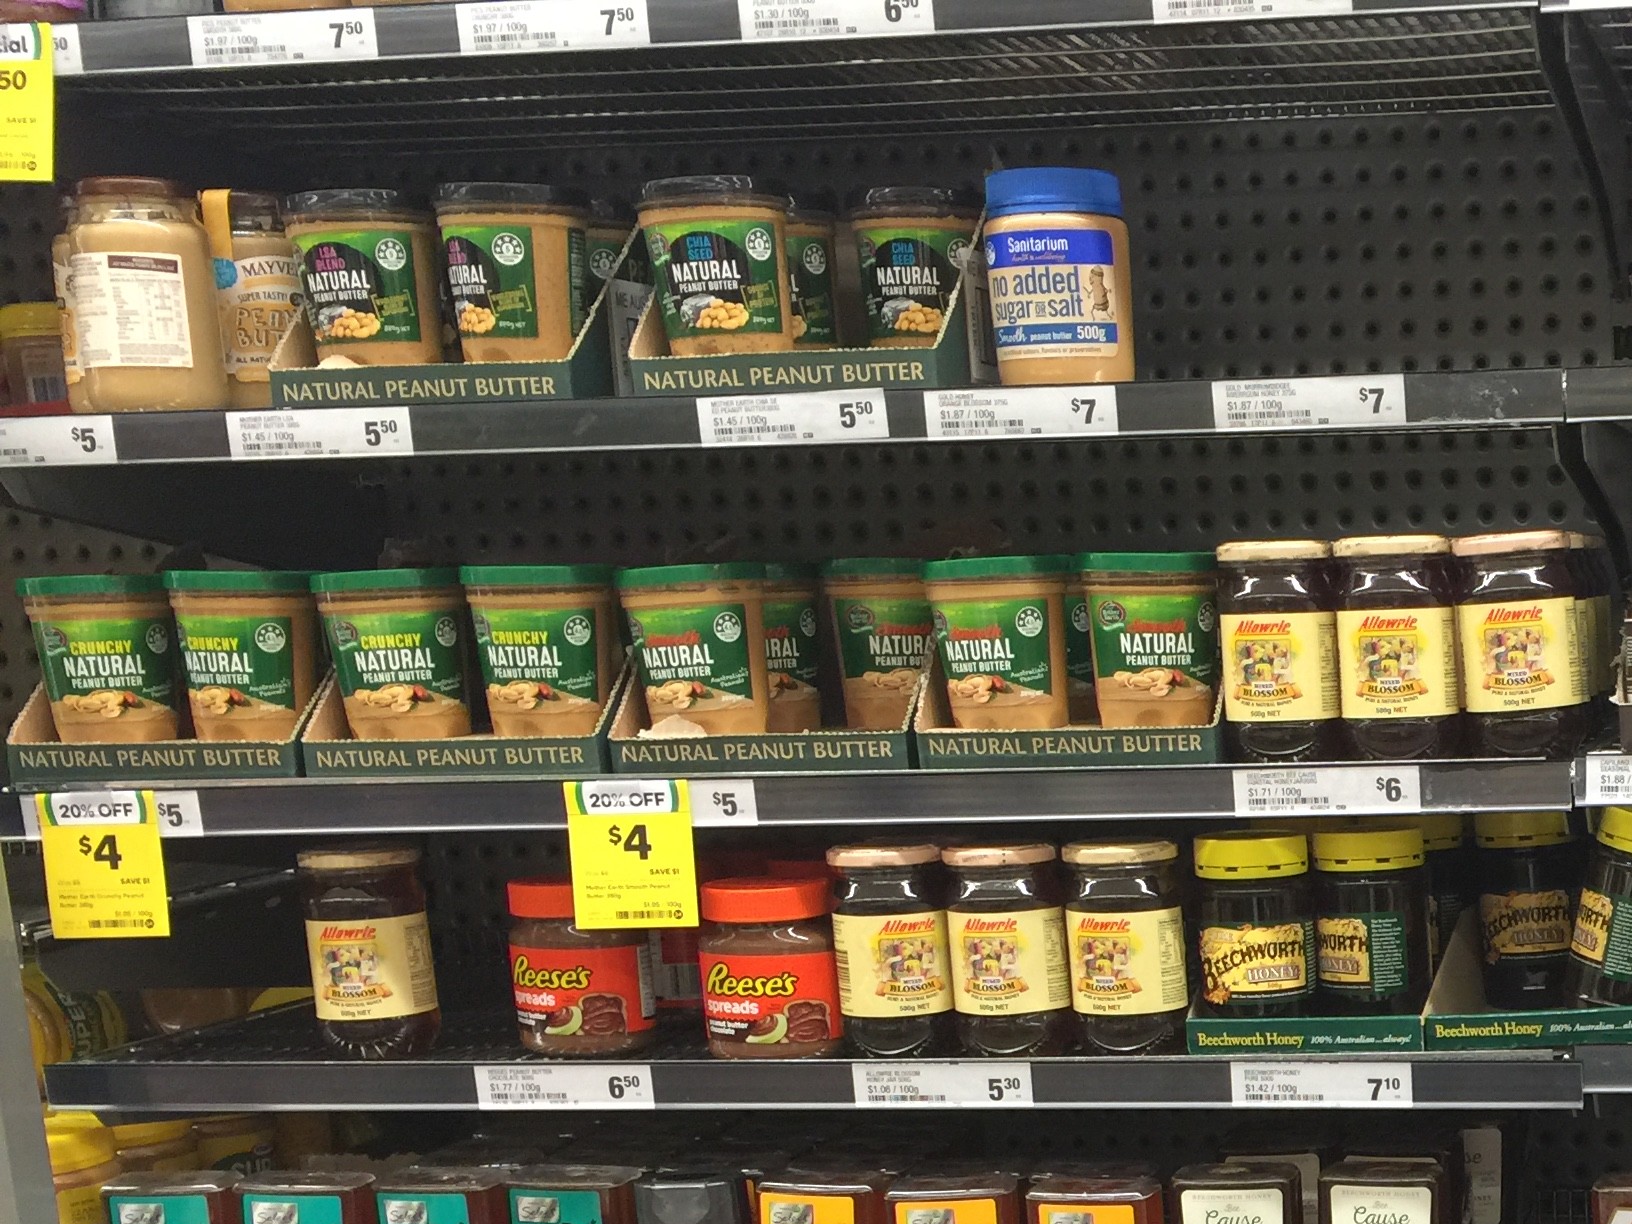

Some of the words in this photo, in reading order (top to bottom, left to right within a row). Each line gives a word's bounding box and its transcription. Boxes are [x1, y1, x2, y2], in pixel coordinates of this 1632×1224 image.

[1007, 237, 1068, 252] Sanitarium
[307, 270, 371, 292] NATURAL
[672, 262, 741, 283] NATURAL
[992, 276, 1014, 298] no
[1018, 266, 1079, 295] added
[995, 299, 1034, 323] sugar
[1048, 294, 1083, 318] salt
[1077, 324, 1107, 342] 500g
[283, 381, 380, 402] NATURAL
[385, 379, 468, 399] PEANUT
[475, 376, 556, 396] BUTTER
[1072, 399, 1096, 424] $7
[71, 427, 96, 454] $5
[1485, 606, 1544, 624] Allowrie
[69, 639, 131, 655] CRUNCHY
[63, 655, 146, 677] NATURAL
[354, 650, 435, 672] NATURAL
[929, 738, 1027, 757] NATURAL
[1033, 737, 1116, 755] PEANUT
[1122, 735, 1202, 752] BUTTER
[19, 749, 109, 769] NATURAL
[116, 748, 196, 768] PEANUT
[202, 747, 281, 768] BUTTER
[589, 792, 624, 808] 20%
[628, 791, 664, 807] OFF
[1376, 777, 1401, 802] $6
[59, 803, 95, 819] 20%
[98, 802, 133, 818] OFF
[608, 825, 651, 860] $4
[963, 917, 1018, 933] Allowrie
[514, 954, 591, 989] Reese's
[708, 961, 798, 997] Reese's
[1248, 967, 1298, 982] HONEY
[708, 999, 759, 1016] spreads
[1436, 1024, 1500, 1040] Beechworth
[1503, 1022, 1543, 1039] Honey
